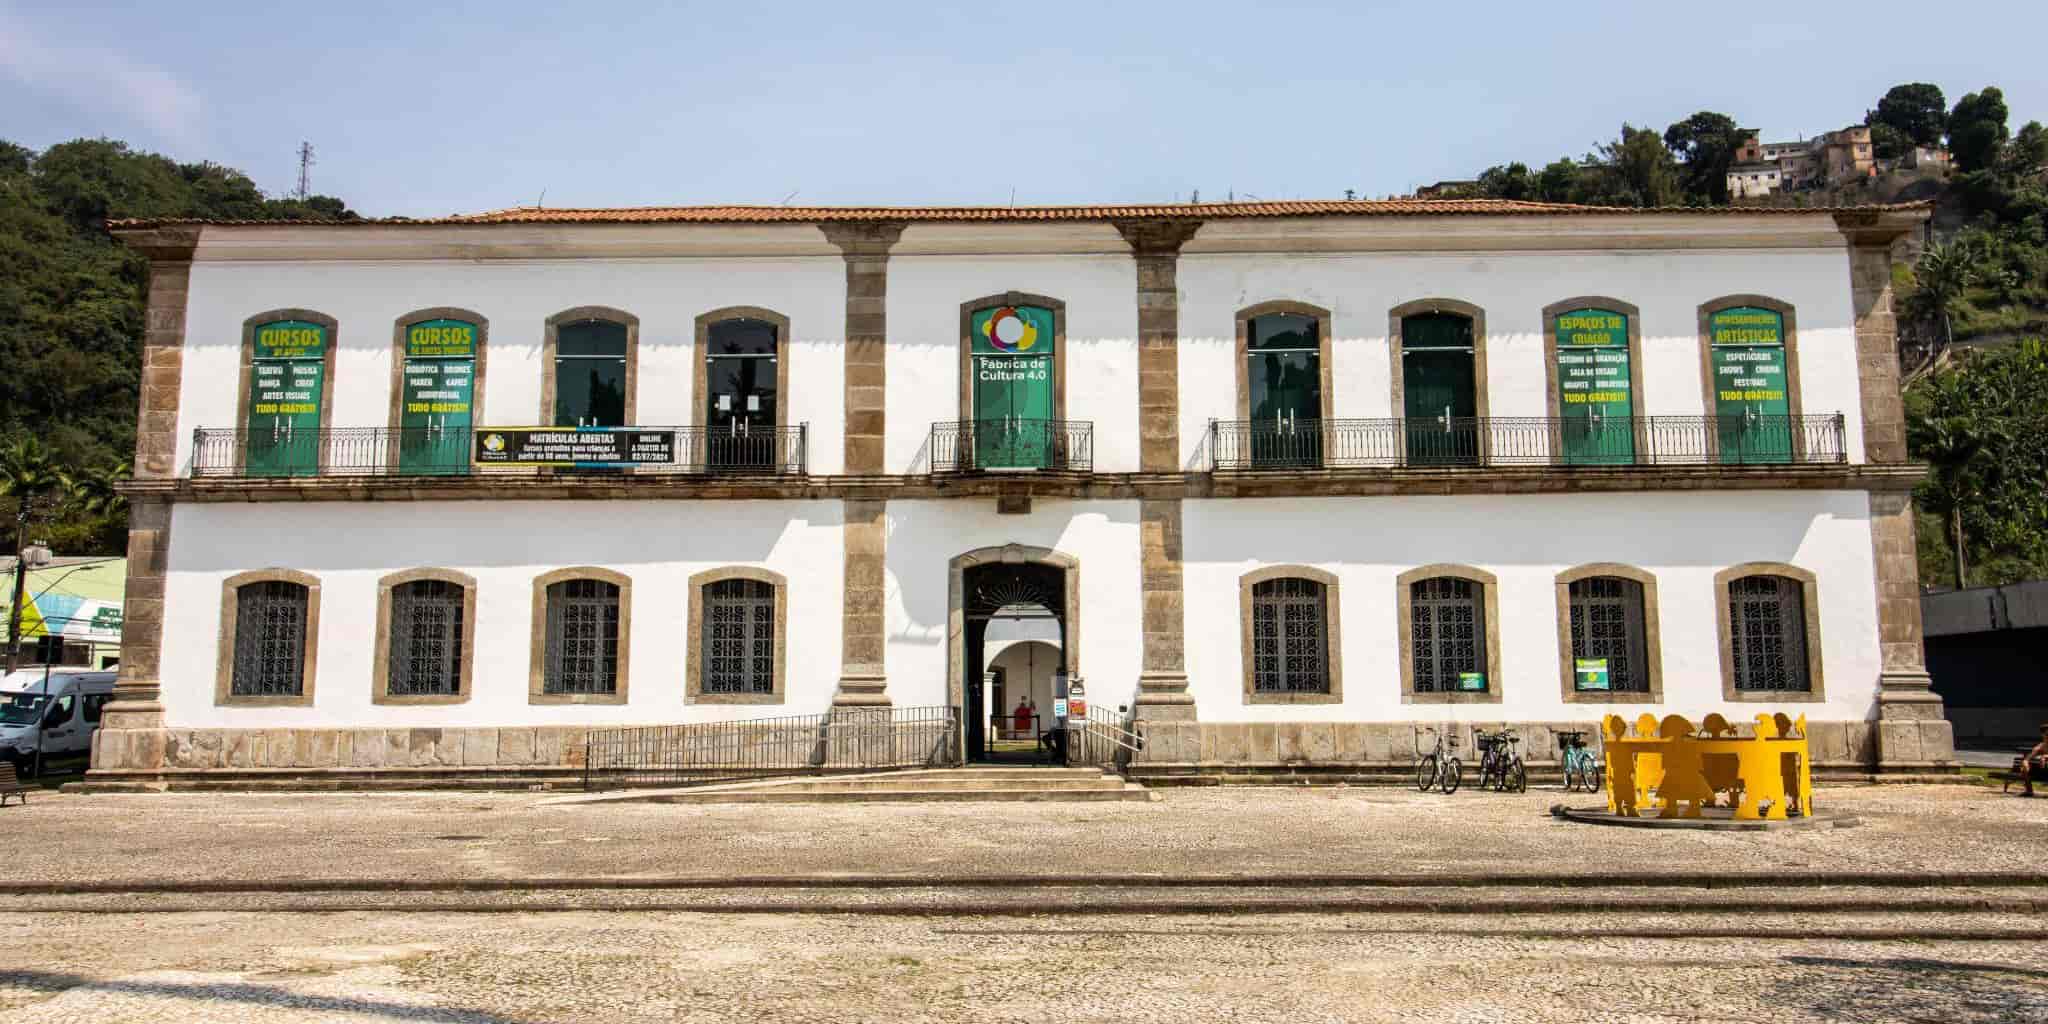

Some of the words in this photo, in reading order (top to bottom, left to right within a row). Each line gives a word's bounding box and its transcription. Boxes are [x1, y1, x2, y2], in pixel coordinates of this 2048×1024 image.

[1560, 316, 1604, 331] ESPAÇOS
[1608, 316, 1621, 329] DE
[261, 329, 320, 346] CURSOS
[411, 327, 471, 345] CURSOS
[1572, 333, 1611, 344] CRIAÇÃO
[1716, 329, 1777, 343] ARTÍSTICAS
[1030, 358, 1046, 369] de
[980, 370, 1025, 380] Cultura
[1027, 370, 1047, 380] 4.0
[1569, 368, 1584, 377] SALA
[1586, 368, 1594, 376] DE
[1563, 392, 1586, 403] TUDO
[1720, 390, 1742, 401] TUDO
[256, 403, 278, 414] TUDO
[408, 402, 430, 413] TUDO
[529, 433, 577, 443] MATRÍCULAS
[579, 433, 615, 443] ABERTAS
[637, 443, 660, 452] PARTIR
[661, 443, 669, 452] DE
